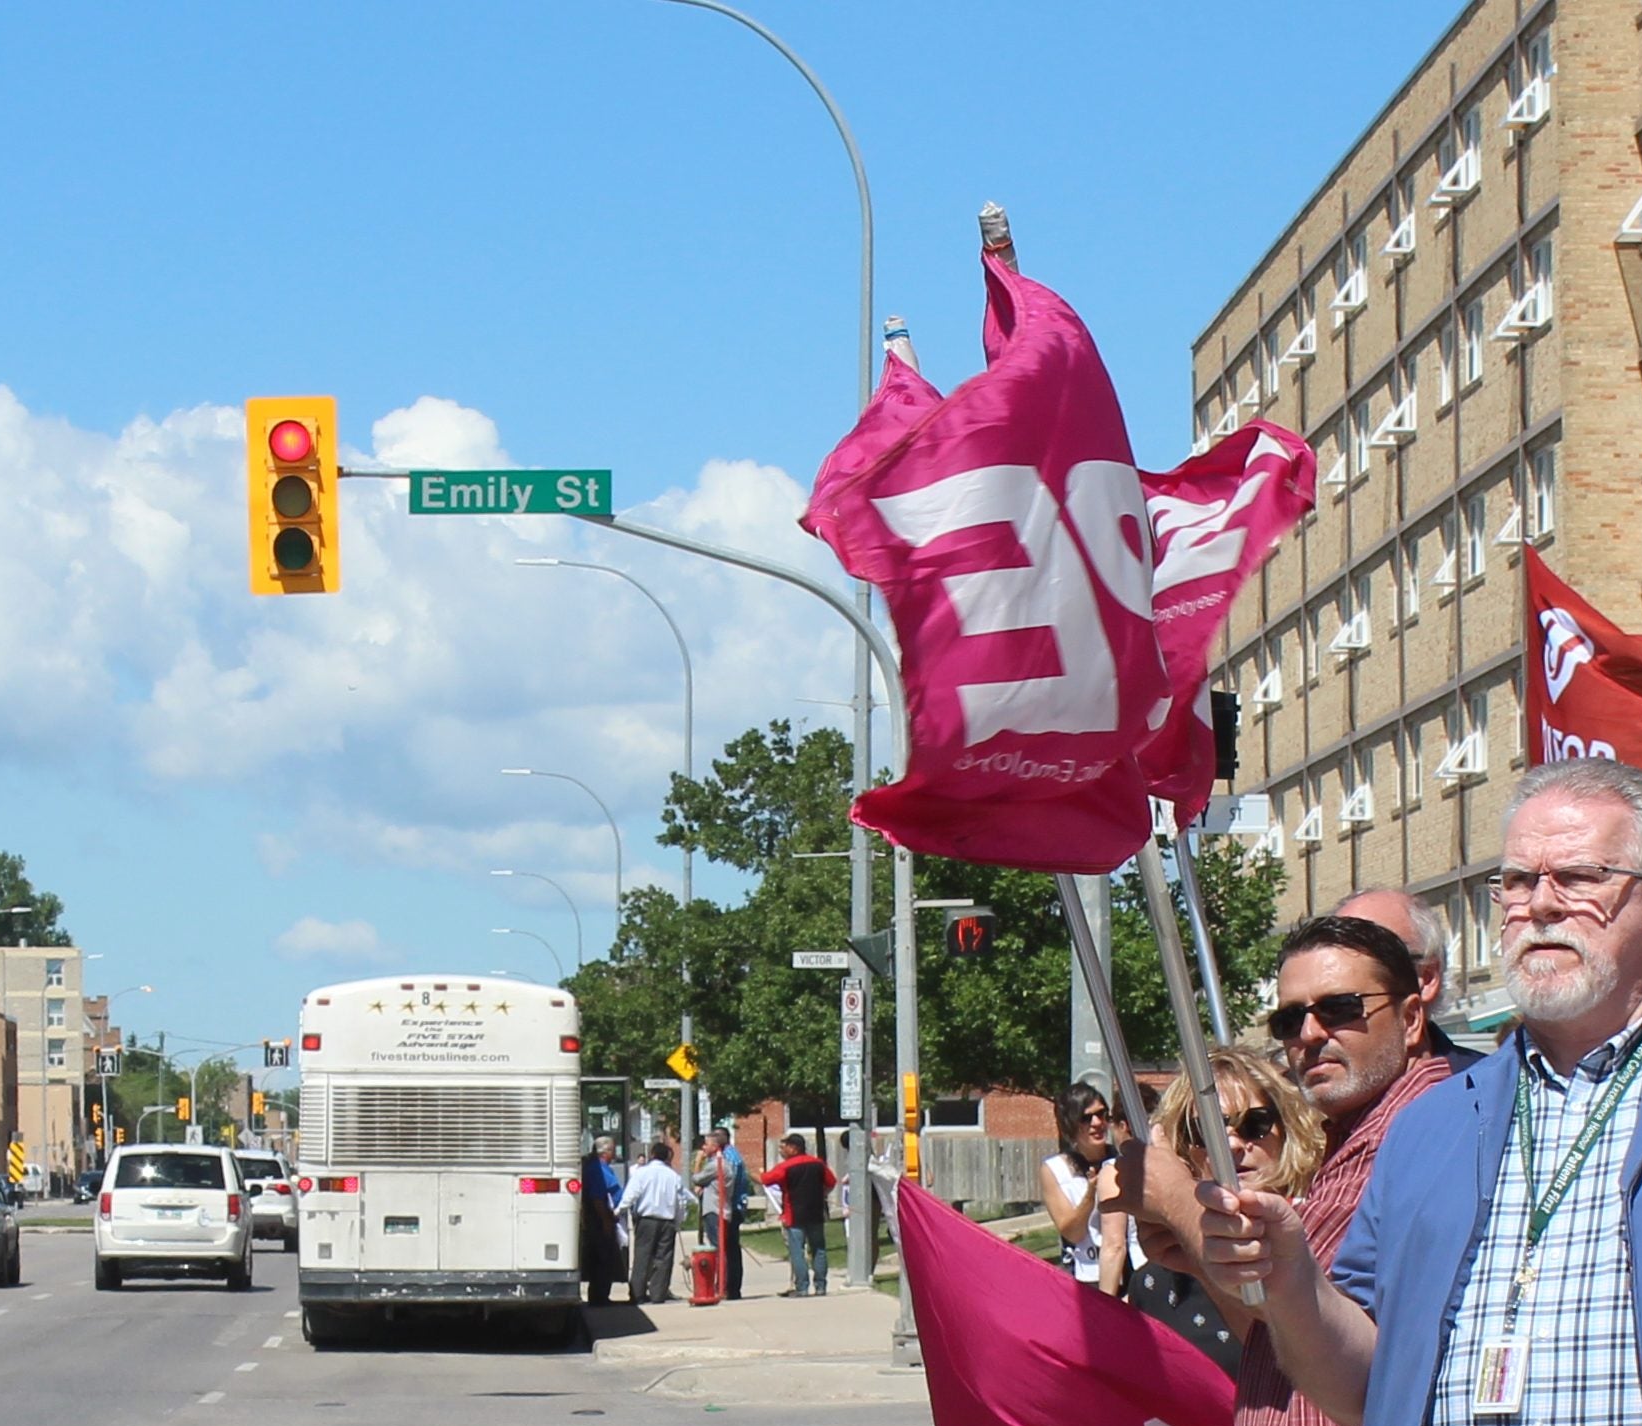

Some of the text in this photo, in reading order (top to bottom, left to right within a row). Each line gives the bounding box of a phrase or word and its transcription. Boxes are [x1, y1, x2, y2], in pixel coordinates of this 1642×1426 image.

[421, 476, 599, 514] Emily St
[800, 955, 832, 966] VICTOR
[422, 992, 430, 1006] 8
[401, 1019, 484, 1027] Experience
[397, 1041, 477, 1049] Advantage
[371, 1052, 510, 1062] fivestarbuslines.com
[1553, 1152, 1583, 1192] Patients
[1541, 1186, 1562, 1214] First
